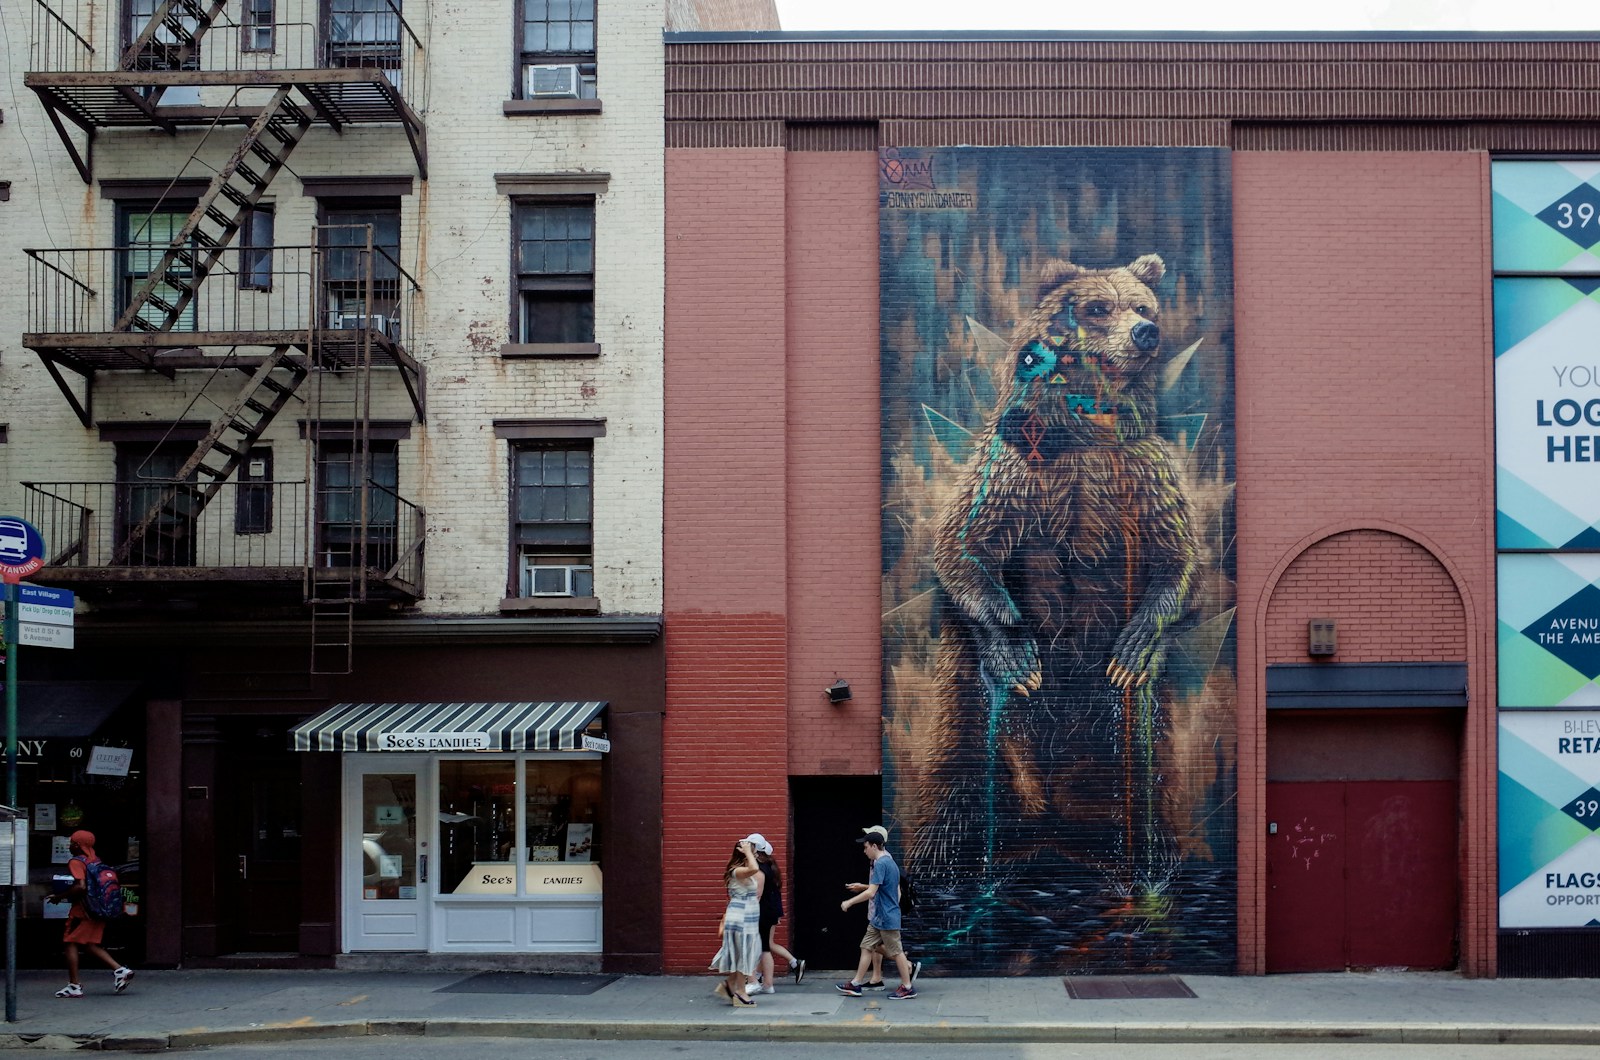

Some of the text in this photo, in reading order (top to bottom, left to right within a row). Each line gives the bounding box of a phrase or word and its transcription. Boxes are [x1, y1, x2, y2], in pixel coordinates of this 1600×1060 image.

[1557, 203, 1600, 229] 39
[22, 589, 60, 599] East Village
[1550, 618, 1598, 630] AVENU
[1539, 633, 1600, 644] THE AME
[387, 735, 481, 748] See's CANDIES
[585, 737, 608, 751] See's CANDIES
[0, 741, 48, 757] NY
[70, 747, 83, 758] 60
[1575, 800, 1599, 817] 39
[482, 875, 583, 885] See's CANDIES
[1546, 895, 1600, 905] OPPORT
